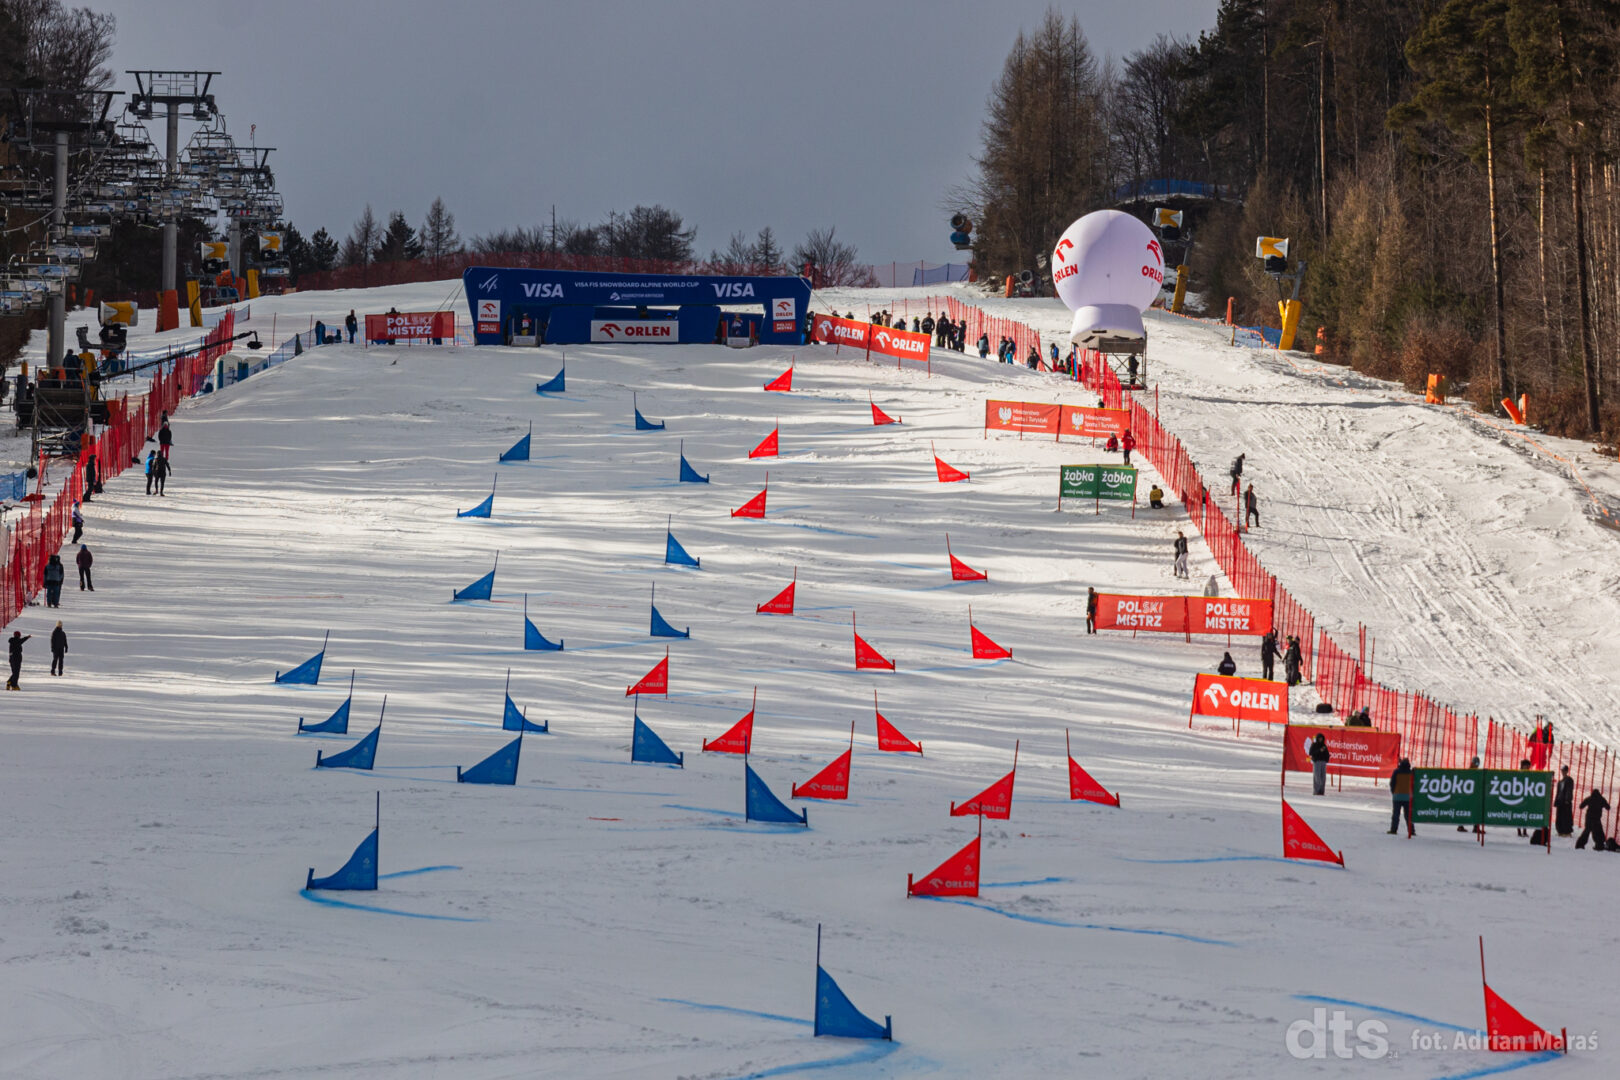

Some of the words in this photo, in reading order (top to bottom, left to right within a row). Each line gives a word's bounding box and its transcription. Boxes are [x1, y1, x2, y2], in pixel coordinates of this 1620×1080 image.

[520, 283, 564, 298] VISA
[710, 283, 755, 297] VISA
[386, 315, 433, 326] POLSKI
[386, 325, 433, 336] MISTRZ
[624, 326, 671, 337] ORLEN
[834, 325, 864, 341] ORLEN
[892, 337, 924, 353] ORLEN
[1064, 468, 1094, 482] żabka
[1102, 471, 1133, 484] żabka
[1117, 600, 1164, 613] POLSKI
[1206, 603, 1250, 616] POLSKI
[1116, 614, 1162, 627] MISTRZ
[1205, 617, 1250, 630] MISTRZ
[1230, 689, 1280, 712] ORLEN
[1326, 738, 1368, 751] Ministerstwo
[1328, 752, 1347, 763] portu
[1352, 752, 1382, 764] Turystyki
[821, 784, 845, 792] ORLEN
[1419, 774, 1475, 794] żabka
[1489, 776, 1546, 797] żabka
[1082, 790, 1106, 798] ORLEN
[1417, 808, 1438, 818] uwolnij
[1440, 807, 1455, 818] swój
[1487, 810, 1512, 820] uwolnij
[1512, 810, 1528, 820] swój
[1302, 842, 1328, 852] ORLEN
[945, 880, 976, 889] ORLEN
